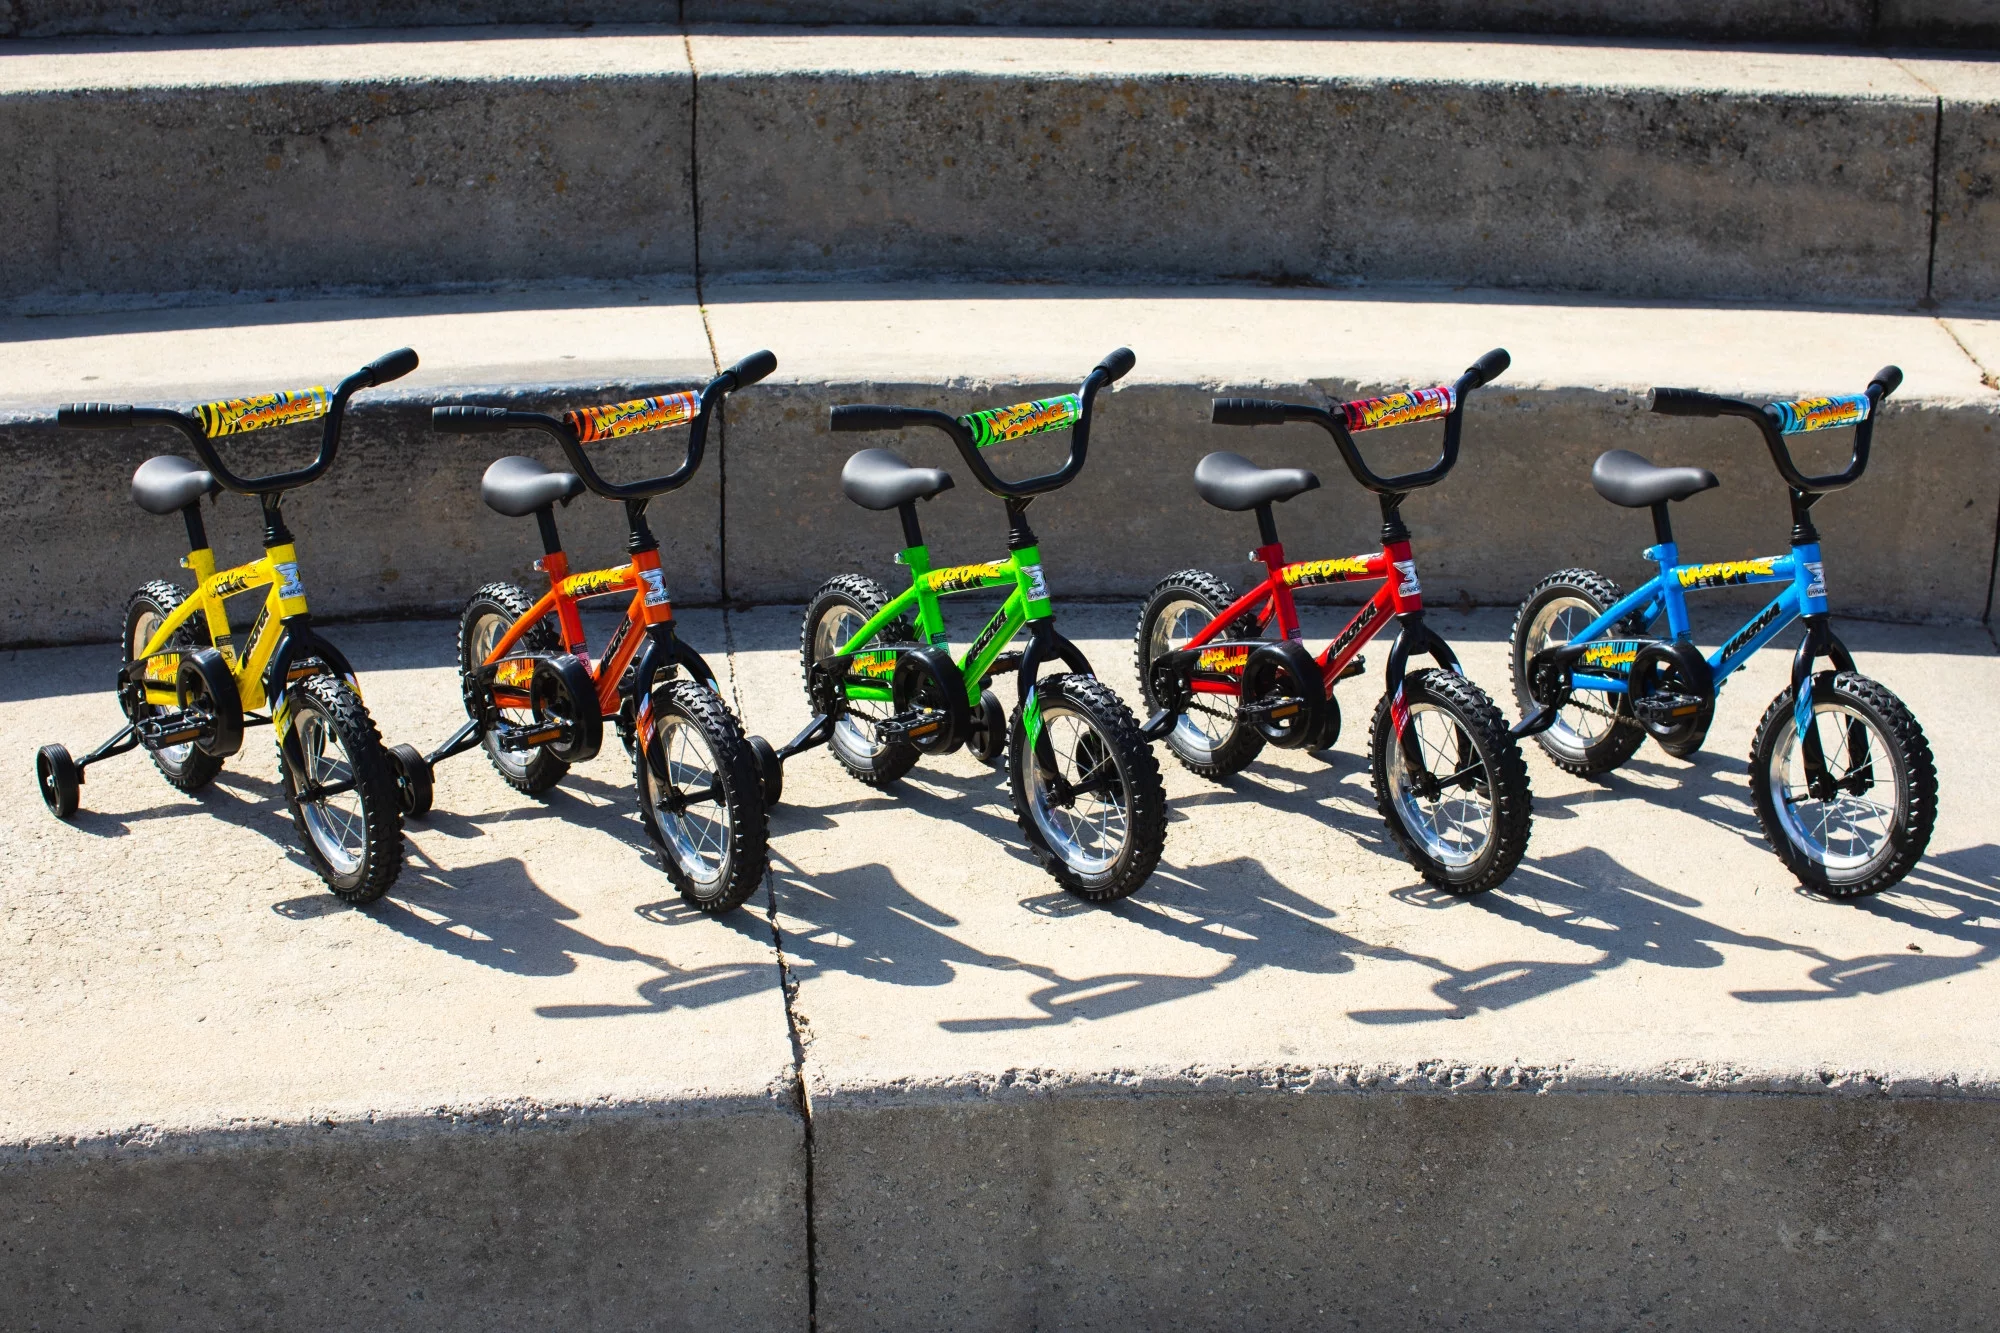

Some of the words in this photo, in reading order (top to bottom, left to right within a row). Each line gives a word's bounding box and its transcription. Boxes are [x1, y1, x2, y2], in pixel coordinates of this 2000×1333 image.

[217, 393, 278, 425] MAJOR
[239, 396, 315, 431] DAMAGE
[591, 399, 650, 432] MAJOR
[611, 402, 685, 438] DAMAGE
[987, 402, 1037, 436] MAJOR
[1004, 402, 1069, 440] DAMAGE
[1361, 393, 1412, 426] MAJOR
[1376, 397, 1442, 428] DAMAGE
[1789, 397, 1831, 421] MAJOR
[1805, 401, 1859, 431] DAMAGE
[563, 571, 591, 597] MAJOR
[927, 567, 961, 592] MAJOR
[960, 563, 1000, 582] DAMAGE
[1282, 560, 1324, 586] MAJOR
[1321, 557, 1368, 577] DAMAGE
[1678, 563, 1722, 588] MAJOR
[1721, 560, 1774, 579] DAMAGE
[965, 607, 1008, 668] MAGNA
[1326, 600, 1378, 663] MAGNA
[1721, 602, 1781, 664] MAGNA
[852, 655, 876, 673] MAJOR
[867, 659, 896, 678] DAMAGE
[1199, 650, 1225, 669] MAJOR
[1214, 654, 1248, 673] DAMAGE
[1585, 645, 1613, 664] MAJOR
[1601, 651, 1637, 668] DAMAGE
